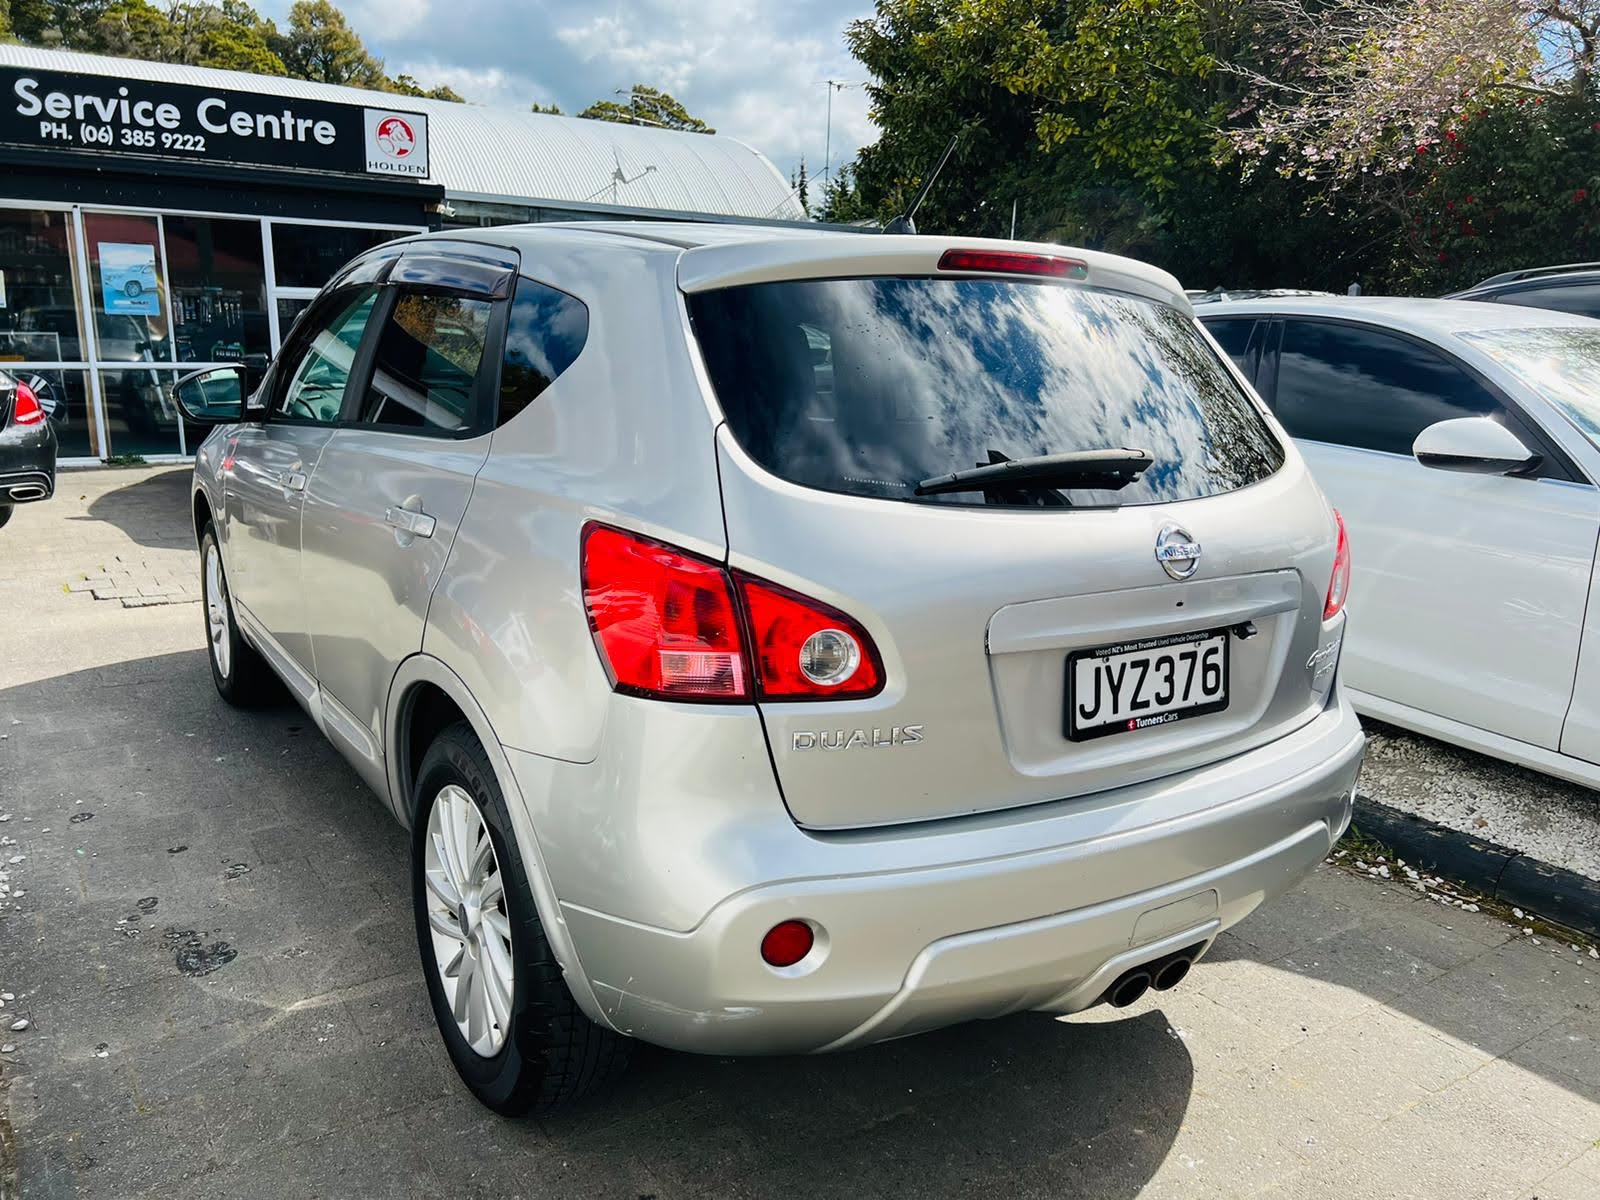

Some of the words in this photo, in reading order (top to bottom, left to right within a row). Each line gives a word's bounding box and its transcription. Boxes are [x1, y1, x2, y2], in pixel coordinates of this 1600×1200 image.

[14, 77, 181, 129] Service
[196, 97, 337, 145] Centre
[40, 121, 73, 140] PH.
[80, 122, 114, 146] (06)
[121, 128, 156, 147] 385
[161, 132, 206, 152] 9222
[368, 161, 426, 174] HOLDEN
[1163, 544, 1201, 558] NISSAN
[1095, 648, 1111, 656] Voted
[1111, 644, 1124, 653] NZ's
[1124, 642, 1138, 652] Most
[1138, 639, 1157, 649] Trusted
[1170, 634, 1186, 644] Vehicle
[1186, 632, 1209, 641] Dealership
[1078, 646, 1221, 720] JYZ376
[792, 724, 925, 751] DUALIS
